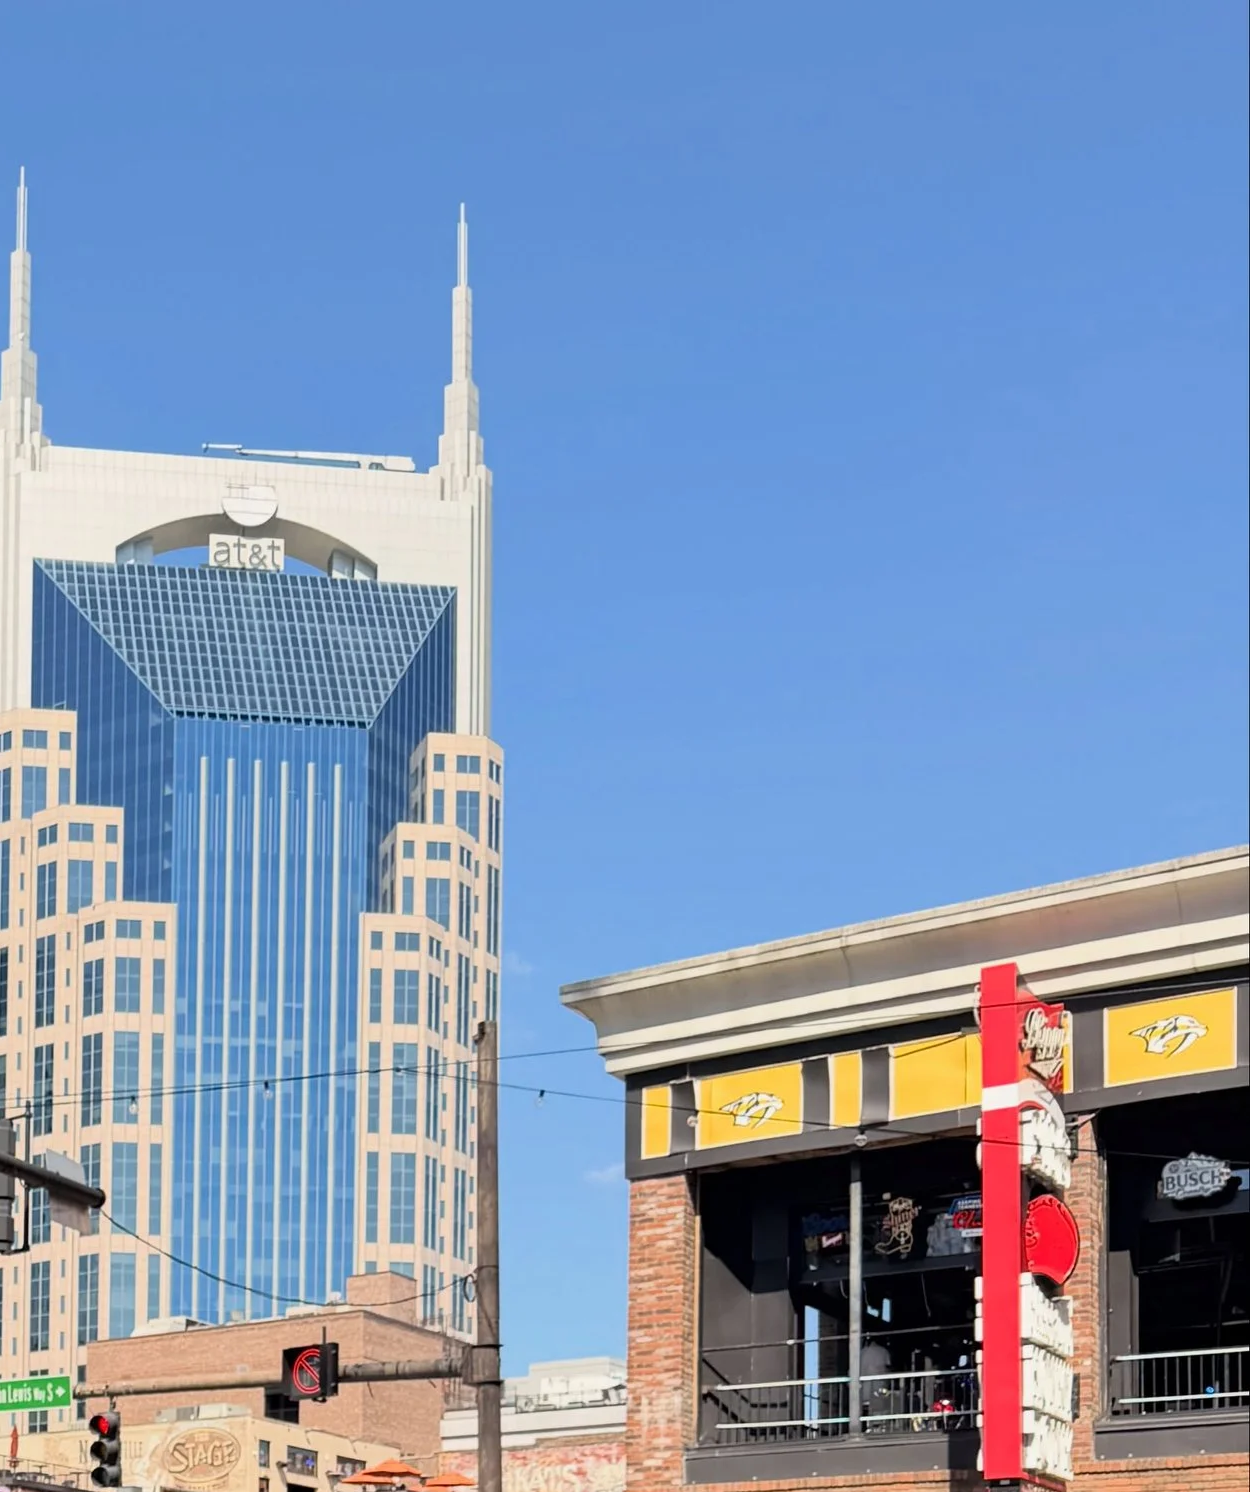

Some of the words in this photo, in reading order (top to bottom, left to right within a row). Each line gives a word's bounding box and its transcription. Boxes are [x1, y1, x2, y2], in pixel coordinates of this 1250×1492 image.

[213, 537, 281, 568] at&t
[1166, 1171, 1221, 1191] BUSCH
[8, 1382, 32, 1403] Lewis
[47, 1383, 54, 1402] S
[79, 1439, 143, 1463] NILLE
[168, 1440, 238, 1473] STAGE
